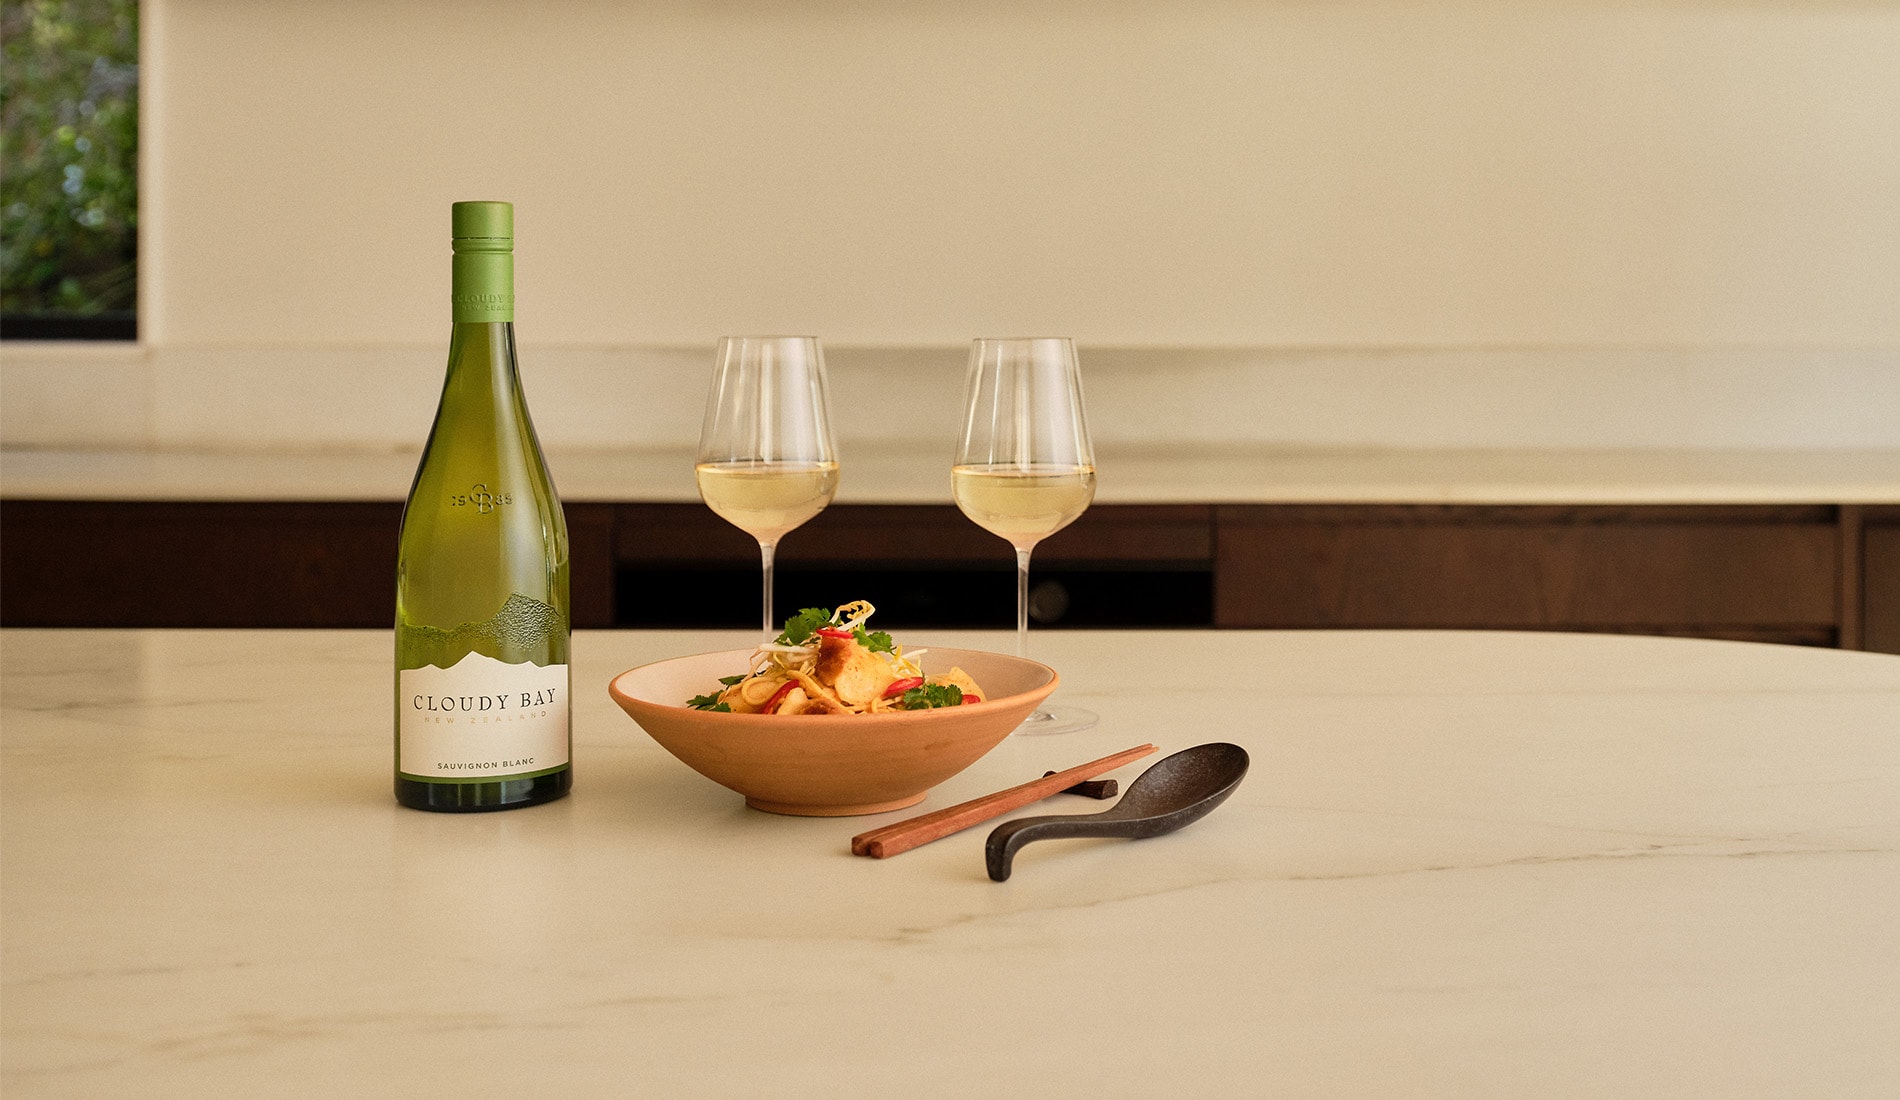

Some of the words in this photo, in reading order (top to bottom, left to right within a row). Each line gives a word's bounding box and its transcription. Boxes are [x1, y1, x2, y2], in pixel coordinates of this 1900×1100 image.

[413, 694, 509, 712] CLOUDY
[520, 688, 556, 708] BAY
[424, 716, 455, 724] NEW
[470, 710, 547, 724] ZEALAND
[437, 762, 498, 770] SAUVIGNON
[502, 757, 535, 768] BLANC
